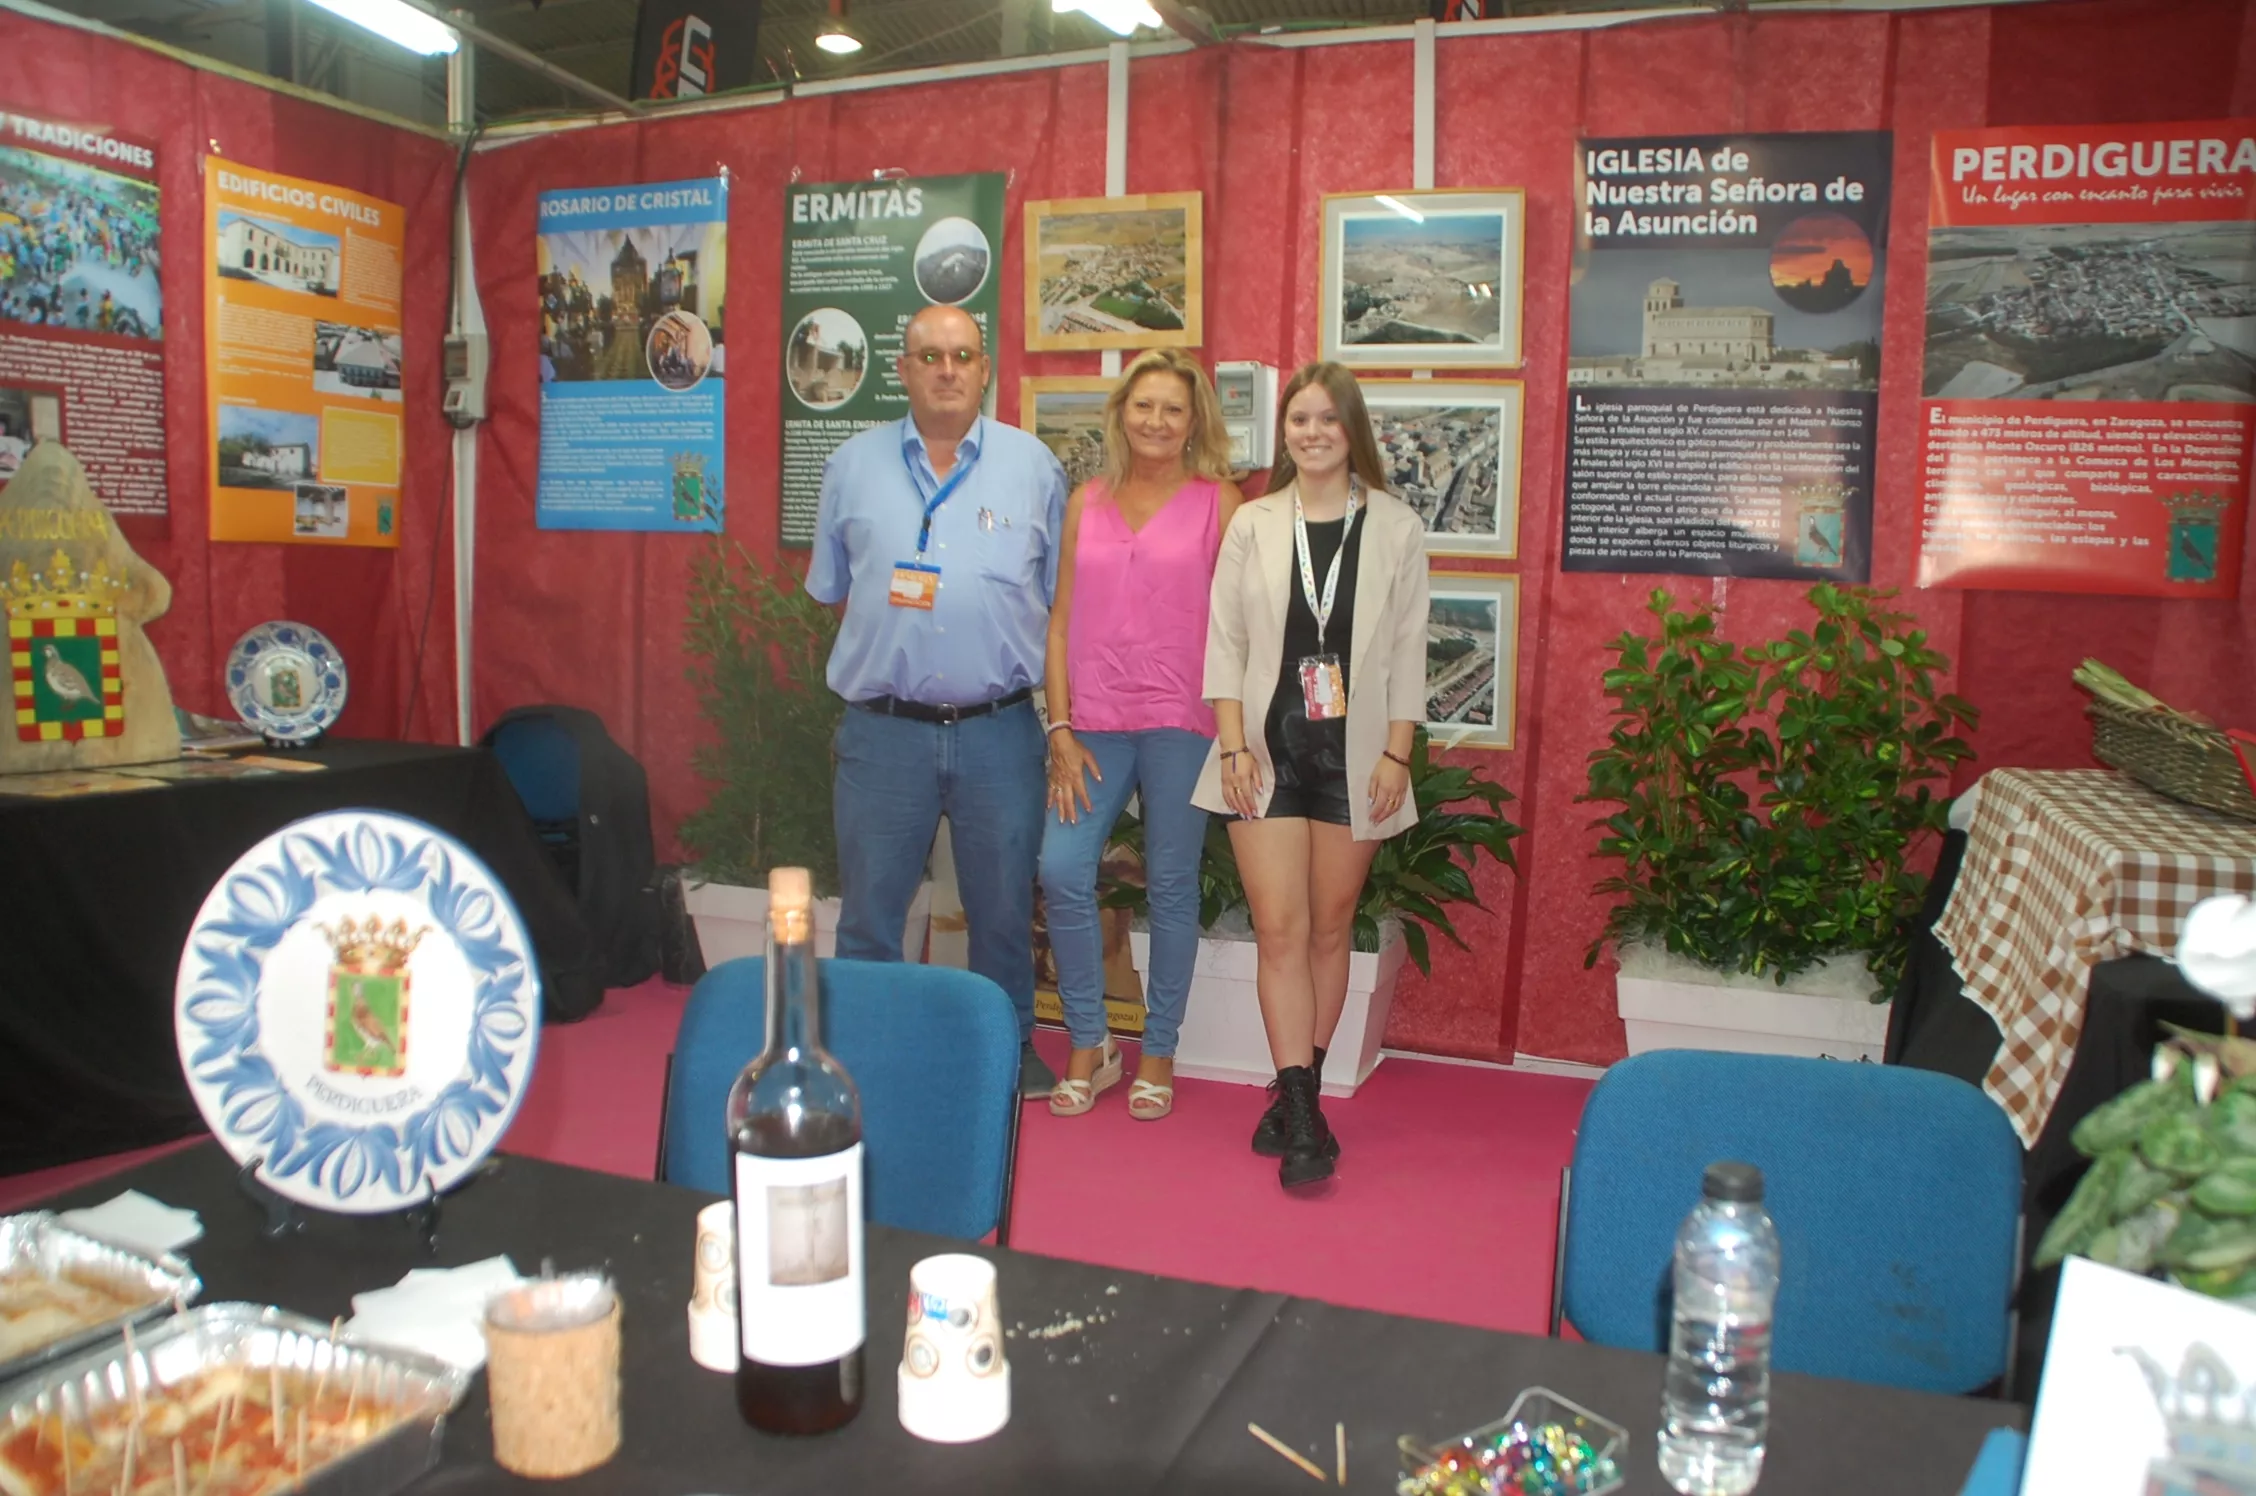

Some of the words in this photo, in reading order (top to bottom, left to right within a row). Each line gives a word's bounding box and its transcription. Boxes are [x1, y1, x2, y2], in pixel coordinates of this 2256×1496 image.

[11, 113, 154, 169] TRADICIONES
[1586, 148, 1705, 175] IGLESIA
[1710, 147, 1748, 172] de
[1952, 138, 2256, 182] PERDIGUERA
[217, 170, 317, 213] EDIFICIOS
[319, 194, 381, 227] CIVILES
[540, 193, 611, 218] ROSARIO
[614, 191, 637, 212] DE
[640, 188, 712, 209] CRISTAL
[792, 186, 923, 223] ERMITAS
[1586, 180, 1702, 205] Nuestra
[1709, 177, 1818, 203] Señora
[1825, 176, 1864, 201] de
[1963, 185, 1988, 204] Un
[1996, 184, 2036, 210] lugar
[2043, 189, 2072, 203] con
[2079, 184, 2147, 203] encanto
[2153, 187, 2194, 205] para
[1585, 211, 1610, 235] la
[1617, 208, 1758, 235] Asunción
